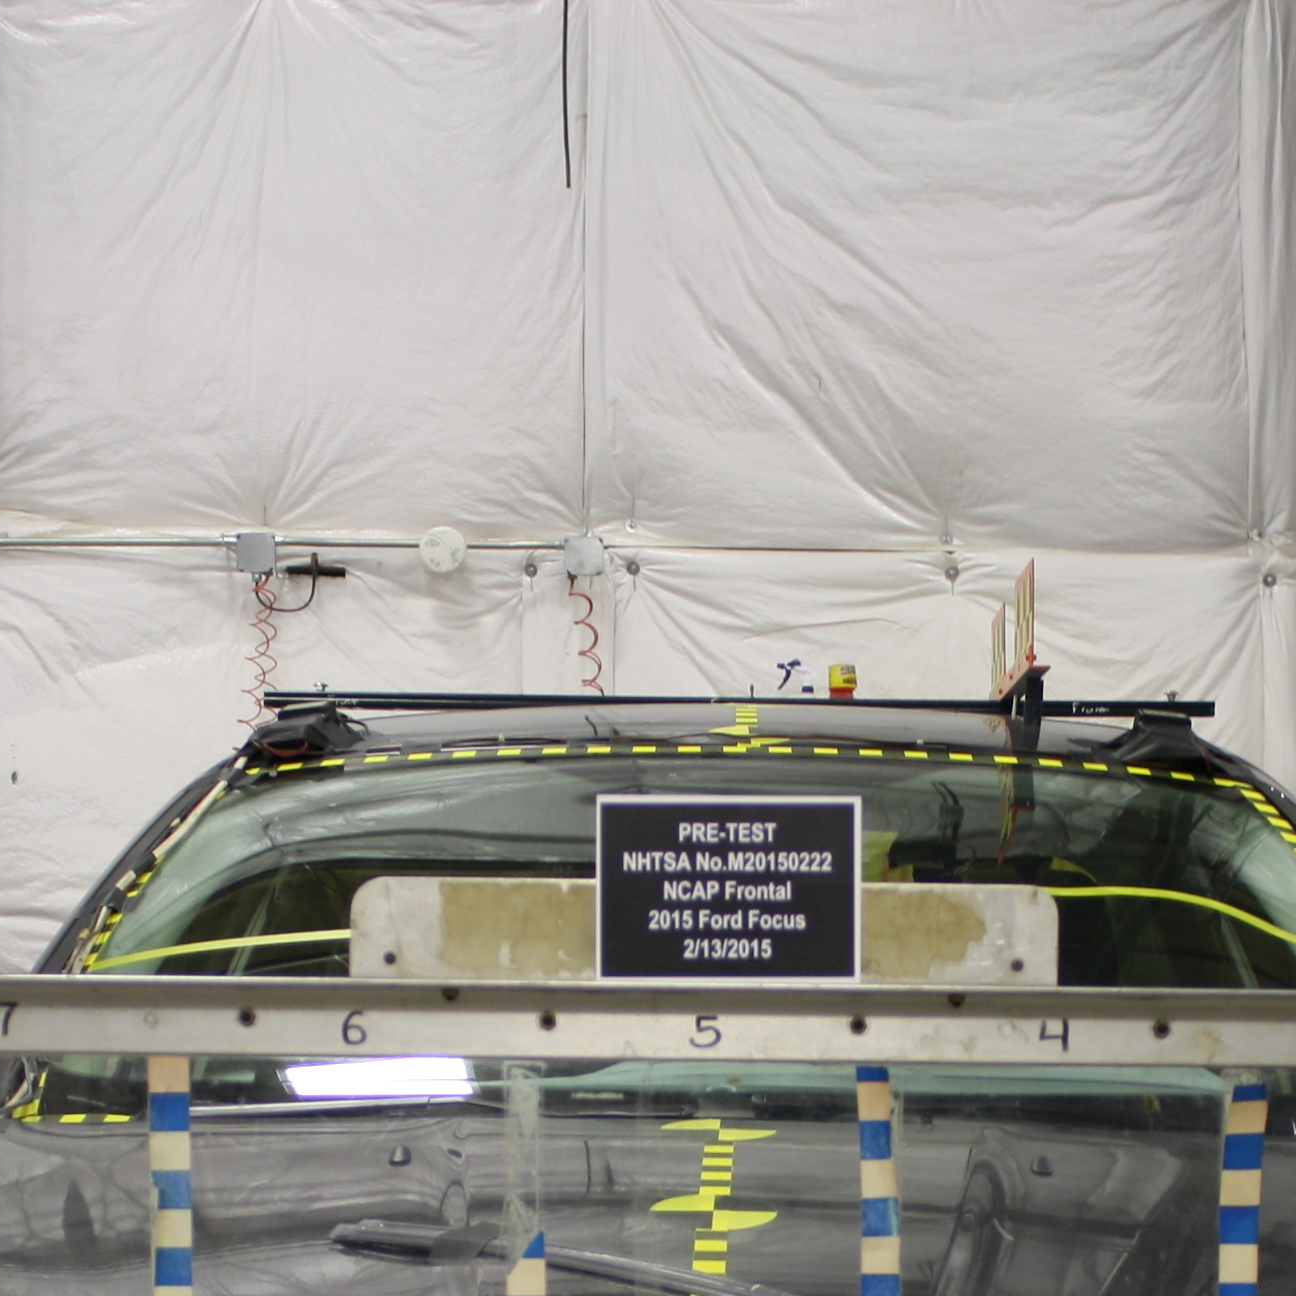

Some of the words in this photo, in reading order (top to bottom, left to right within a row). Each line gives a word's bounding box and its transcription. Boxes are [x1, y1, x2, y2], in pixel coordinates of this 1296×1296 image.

[678, 822, 777, 843] PRE-TEST
[622, 852, 691, 872] NHTSA
[696, 852, 832, 872] No.M20150222
[663, 881, 720, 901] NCAP
[725, 880, 792, 900] Frontal
[648, 909, 694, 931] 2015
[699, 909, 742, 930] Ford
[748, 910, 806, 931] Focus
[682, 938, 772, 959] 2/13/2015
[341, 1010, 368, 1045] 6
[689, 1015, 722, 1048] 5
[1039, 1017, 1070, 1051] 4
